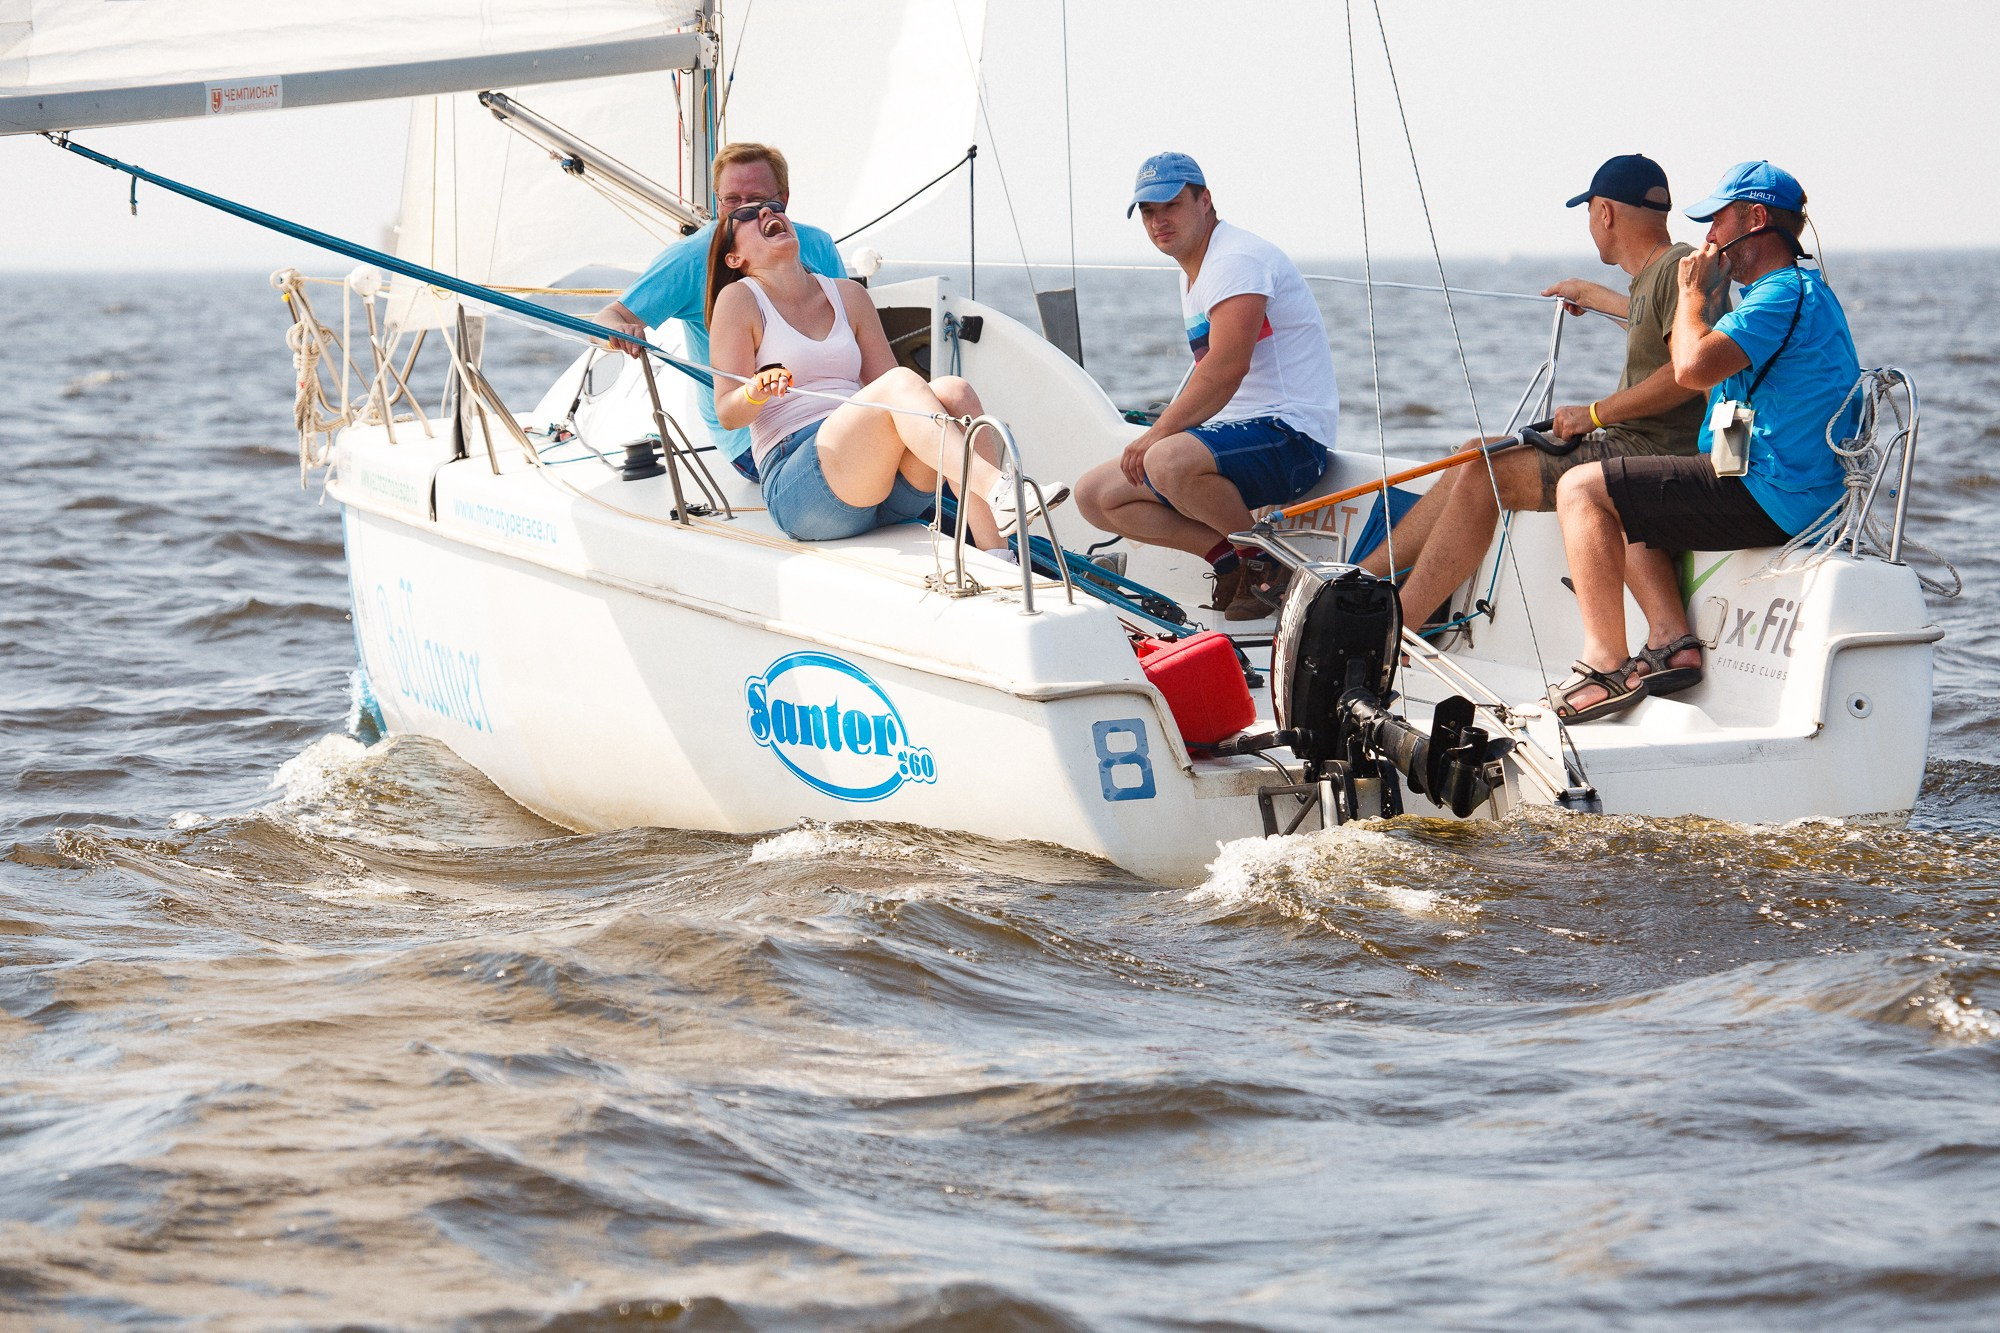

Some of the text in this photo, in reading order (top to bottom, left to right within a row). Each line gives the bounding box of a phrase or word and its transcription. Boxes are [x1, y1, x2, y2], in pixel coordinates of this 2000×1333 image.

[224, 84, 279, 101] ЧЕМПИОНАТ
[1749, 190, 1776, 202] HALTI
[453, 498, 557, 544] www.monotyperace.ru
[1717, 657, 1788, 681] FITNESS CLUBS
[748, 682, 897, 757] Santer
[1092, 718, 1156, 802] 8
